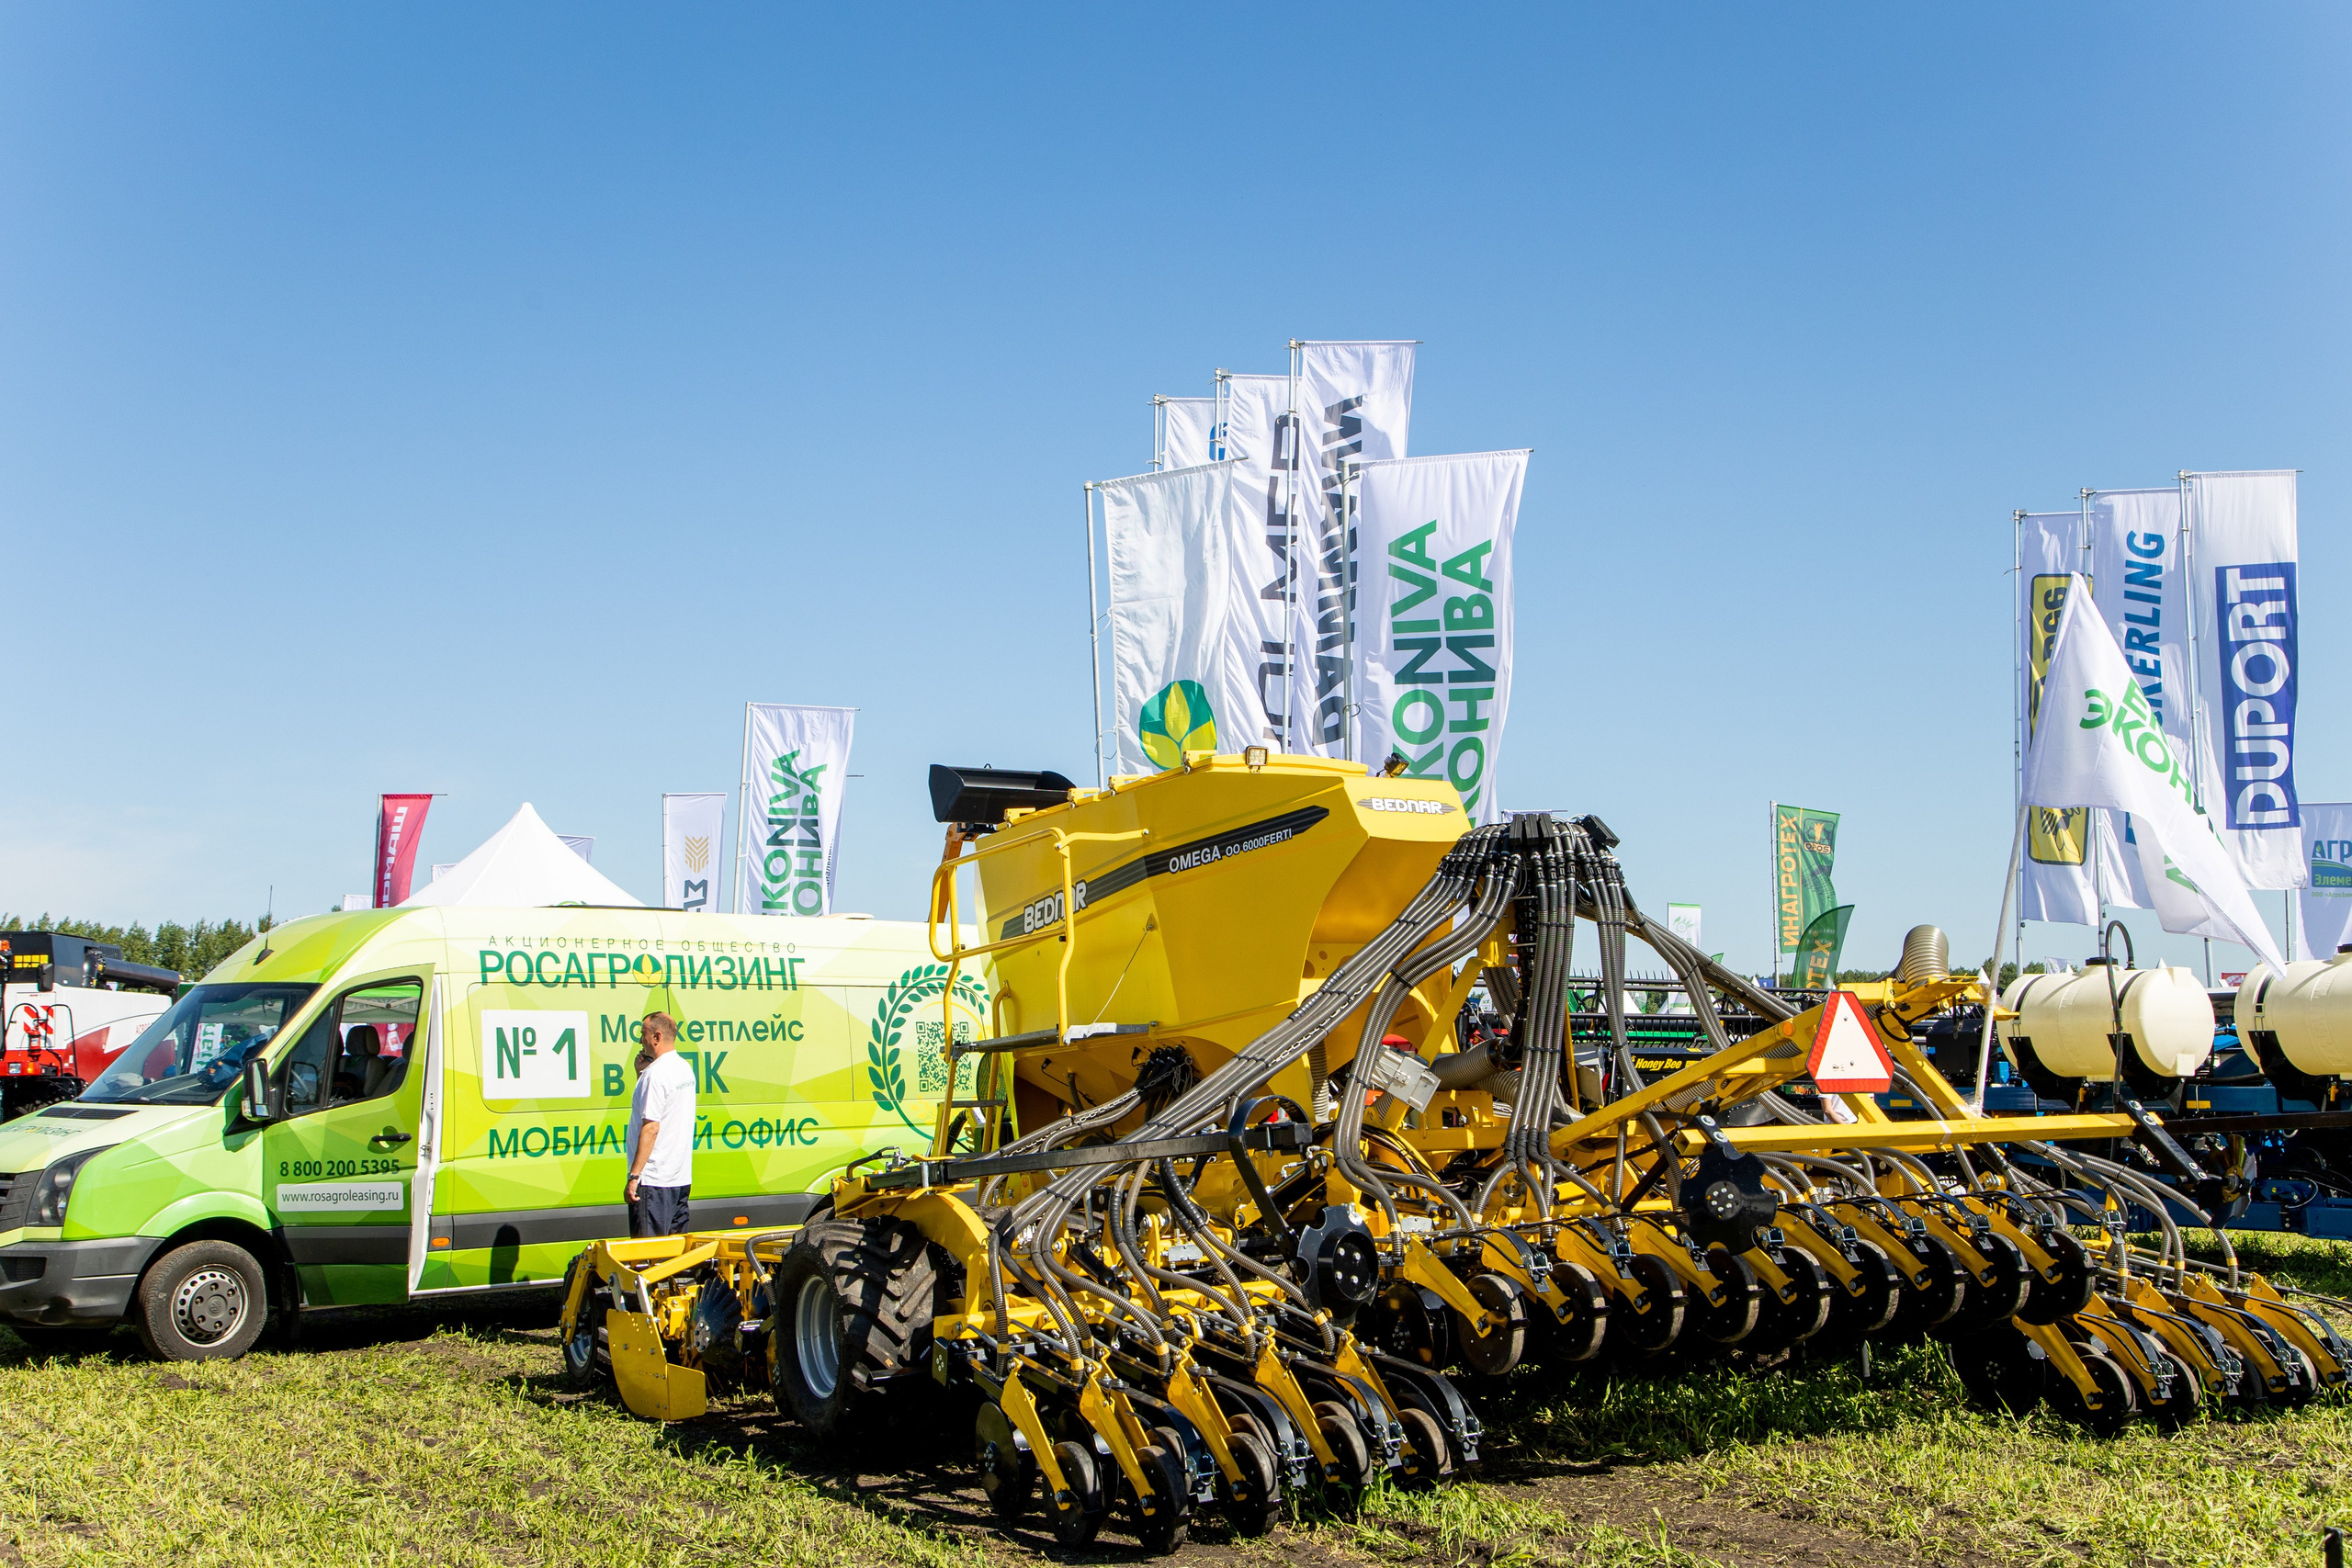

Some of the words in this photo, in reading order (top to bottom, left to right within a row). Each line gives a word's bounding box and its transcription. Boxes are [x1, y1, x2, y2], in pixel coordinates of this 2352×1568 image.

[2226, 568, 2290, 825] DUPORT
[1371, 797, 1444, 814] BEDNAR
[762, 749, 800, 916] KONIVA
[791, 763, 828, 916] ОНИВА
[1169, 844, 1222, 874] OMEGA
[1242, 828, 1293, 852] 6000FERTI
[1780, 814, 1800, 947] ИНАГРОТЕХ
[1023, 879, 1088, 934] BEDNR
[489, 935, 664, 951] АКЦИОНЕРНОЕ
[681, 940, 797, 953] ОБЩЕСТВО
[600, 1014, 804, 1044] Макетплейс
[496, 1027, 537, 1079] №
[552, 1028, 578, 1081] 1
[676, 1051, 730, 1095] ПК
[1635, 1058, 1663, 1072] Honey
[1663, 1058, 1682, 1069] Bee
[489, 1115, 713, 1159] МОБИЛЙ
[722, 1117, 820, 1149] ОФИС
[279, 1161, 289, 1177] 8
[293, 1161, 322, 1177] 800
[326, 1160, 356, 1176] 200
[360, 1159, 401, 1175] 5395
[281, 1190, 399, 1204] www.rosagroleasing.ru
